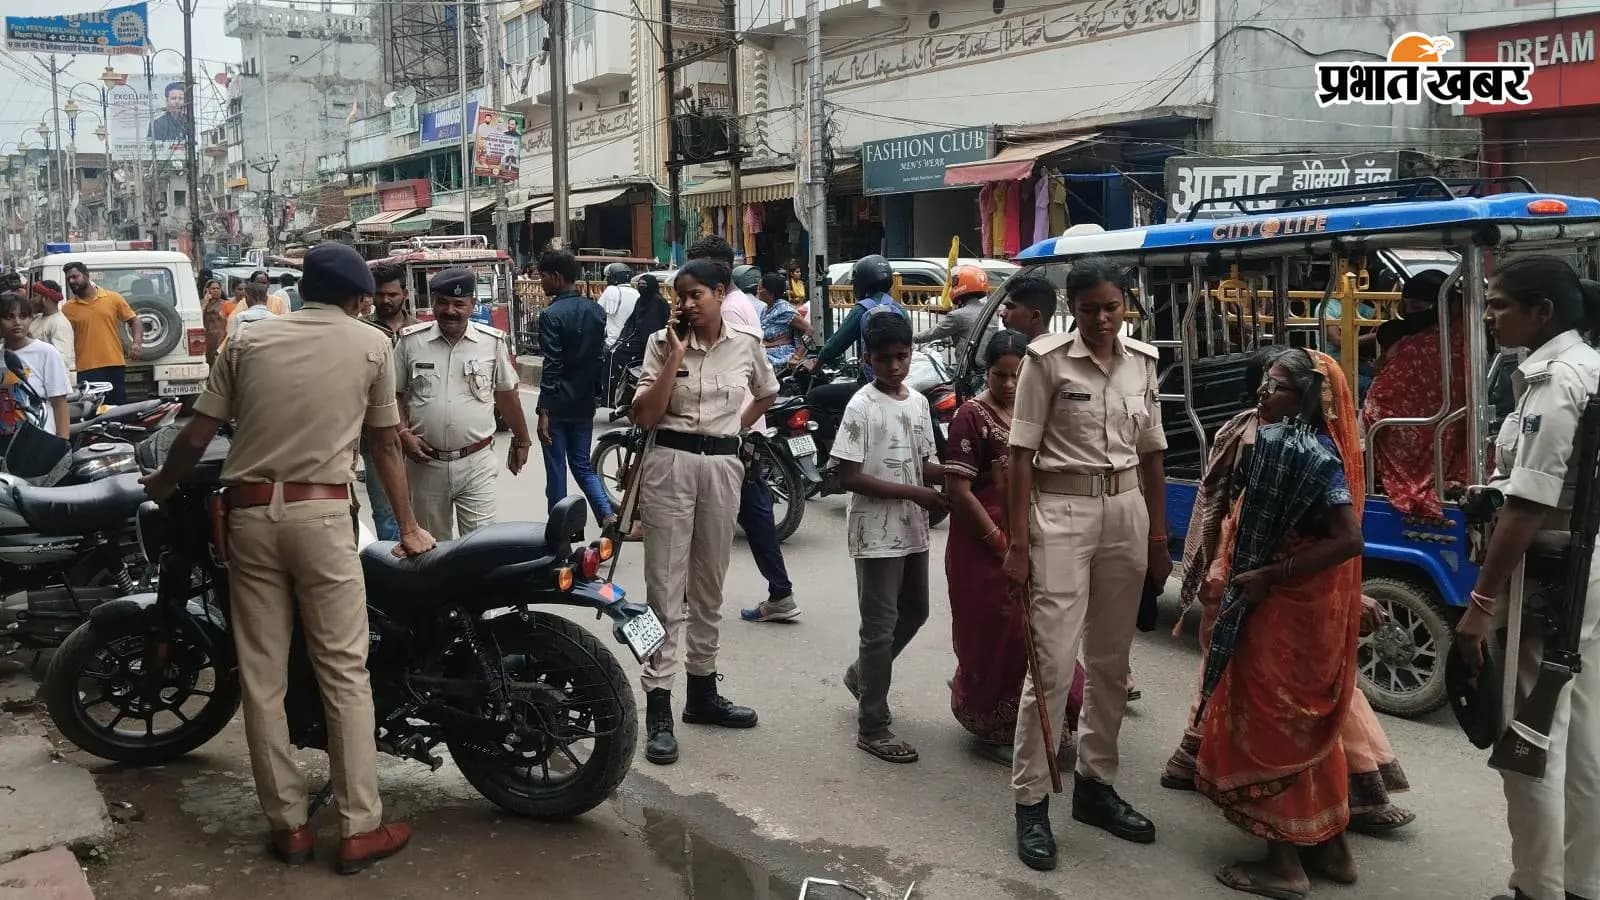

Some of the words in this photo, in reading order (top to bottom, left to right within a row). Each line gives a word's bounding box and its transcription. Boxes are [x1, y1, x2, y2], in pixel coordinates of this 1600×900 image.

[1498, 30, 1595, 67] DREAM
[866, 137, 934, 162] FASHION
[940, 130, 984, 153] CLUB
[924, 157, 945, 168] WEAR
[1292, 159, 1350, 191] होमियो
[1212, 222, 1259, 240] CITY
[1283, 214, 1329, 234] LIFE
